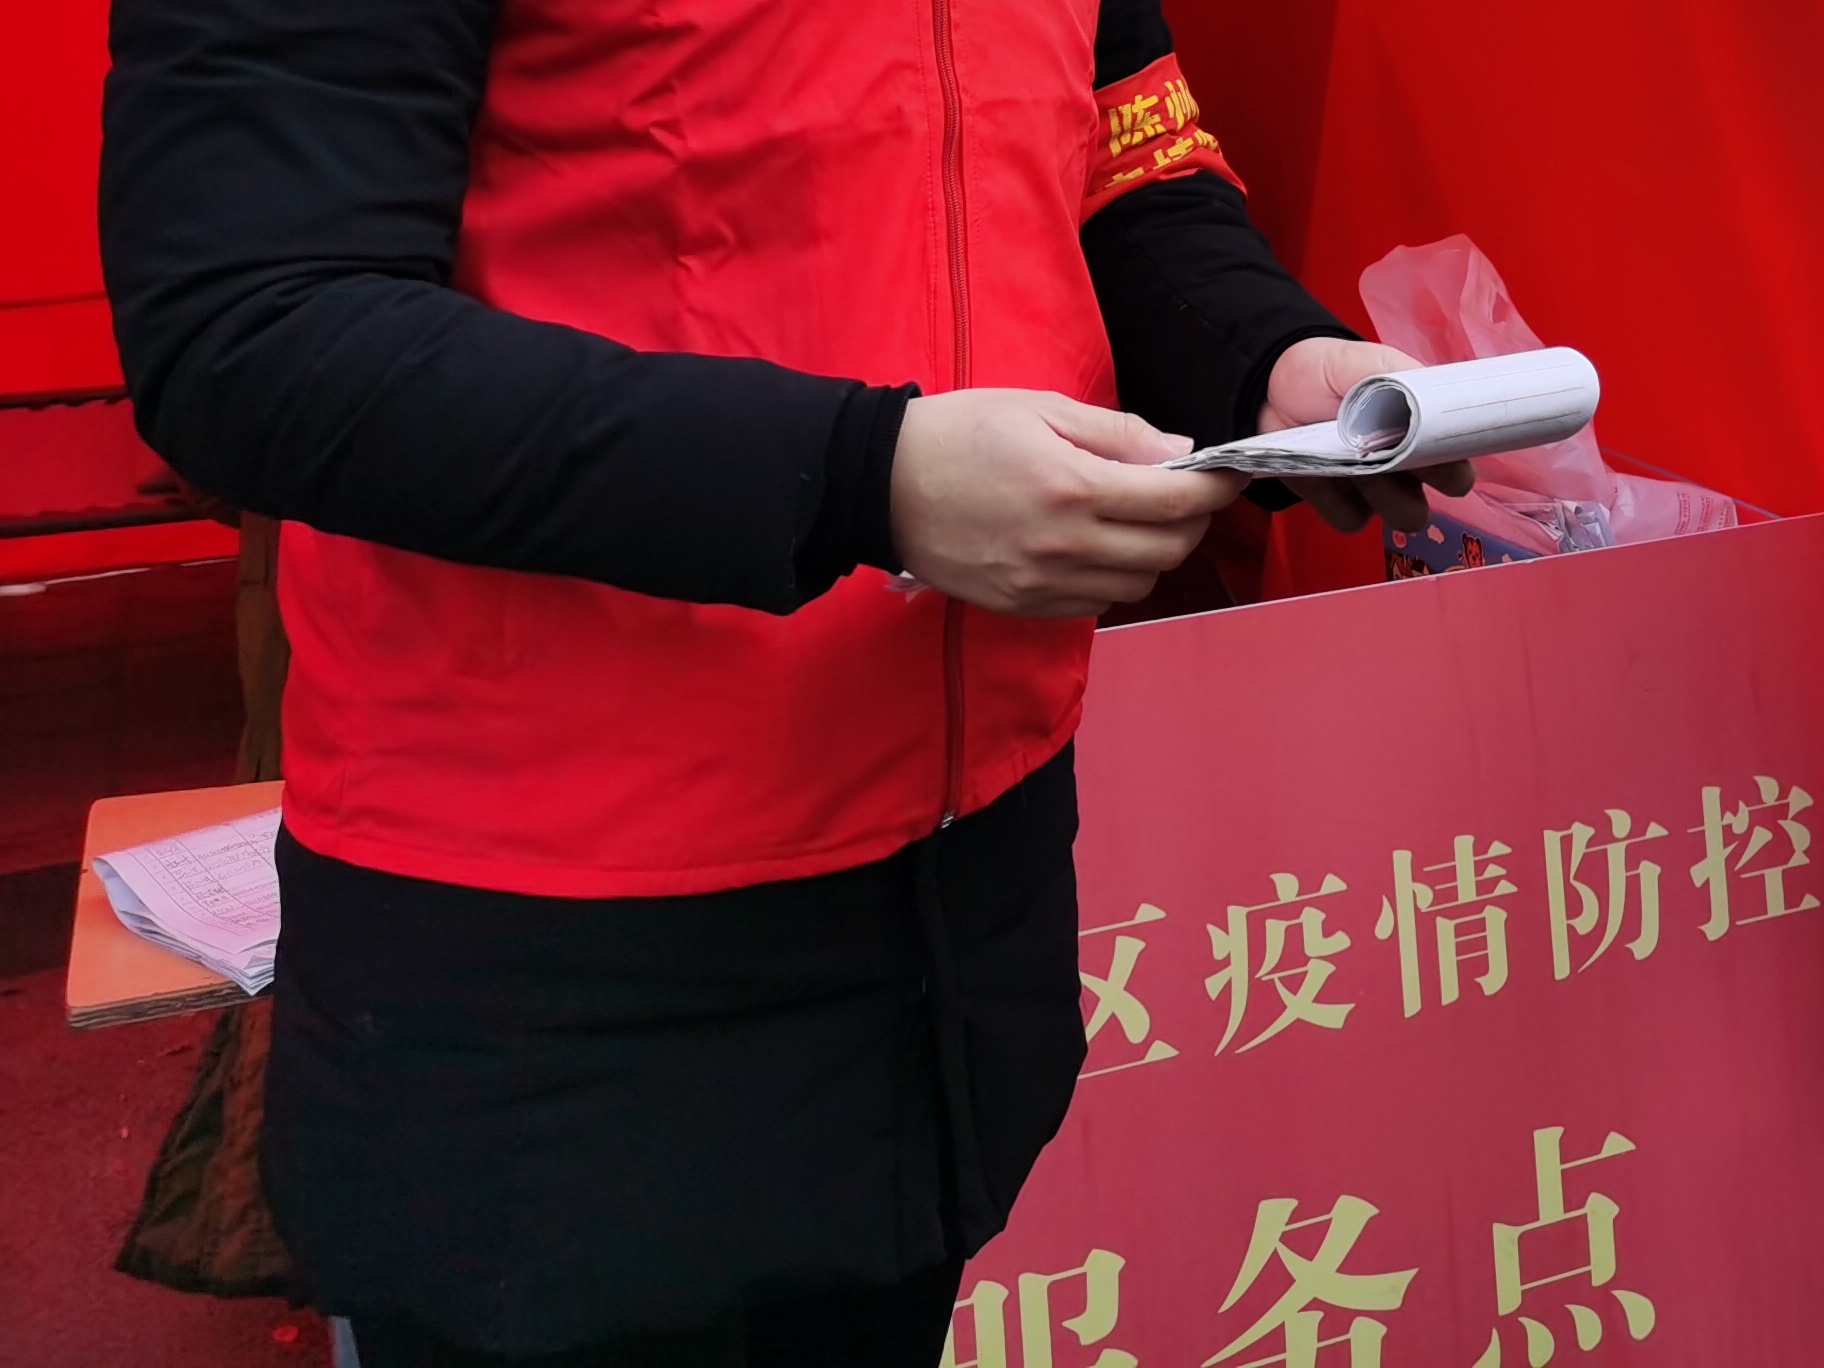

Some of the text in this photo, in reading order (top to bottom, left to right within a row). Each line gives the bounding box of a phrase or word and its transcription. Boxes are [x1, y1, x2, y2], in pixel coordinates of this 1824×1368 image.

[1077, 774, 1821, 1080] 区疫情防控
